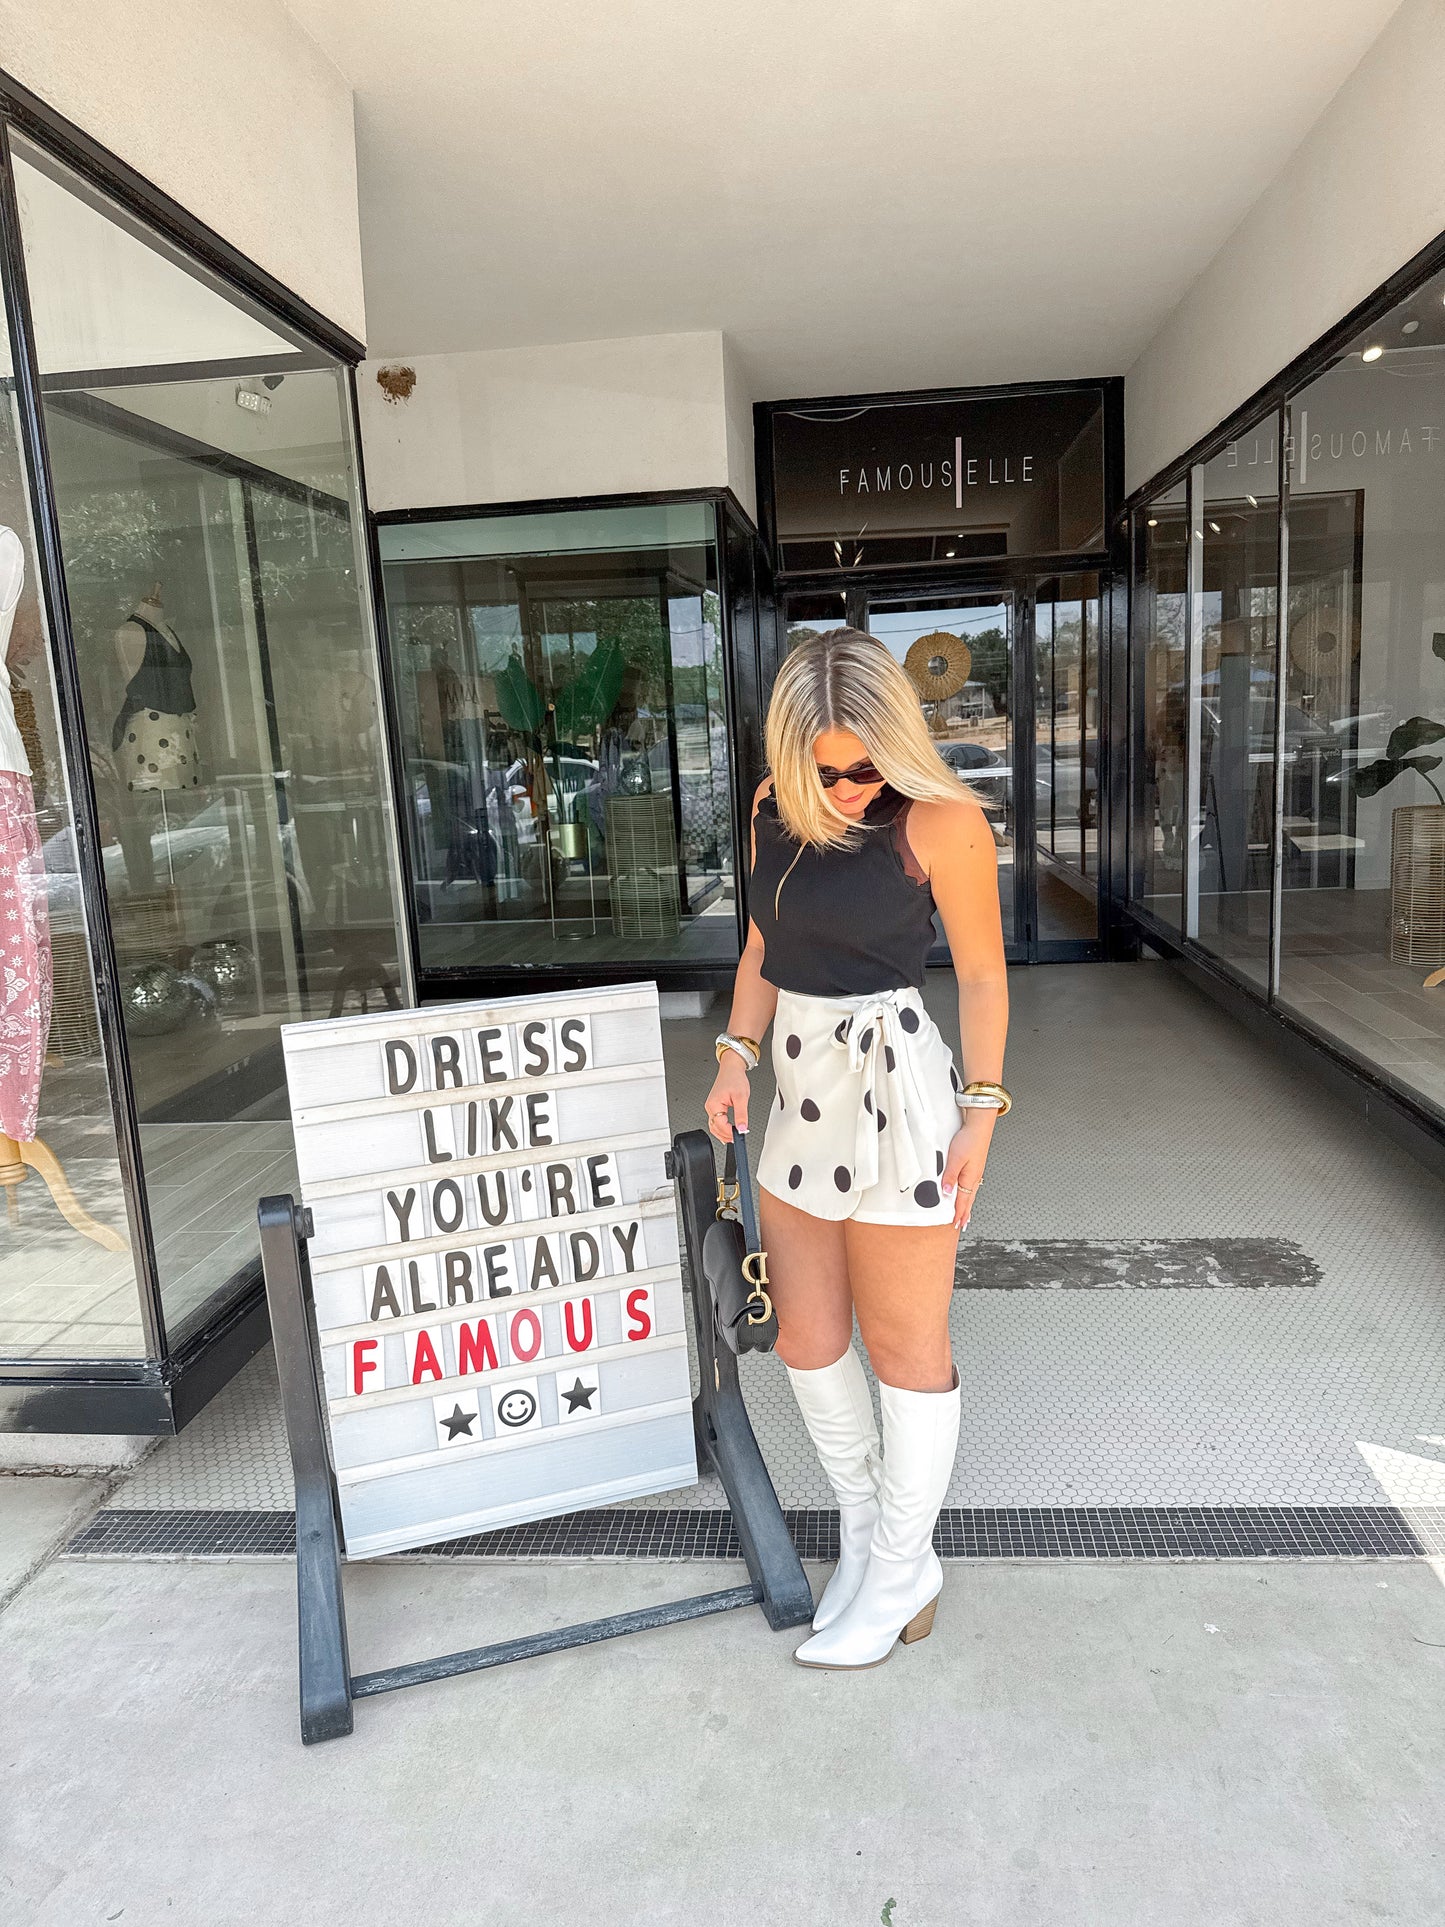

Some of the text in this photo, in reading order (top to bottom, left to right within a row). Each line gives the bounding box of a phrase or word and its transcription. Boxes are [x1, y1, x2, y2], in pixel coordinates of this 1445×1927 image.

[839, 456, 1033, 495] FAMOUS ELLE
[384, 1019, 587, 1095] DRESS
[423, 1092, 553, 1163] LIKE
[386, 1153, 616, 1242] YOU'RE
[370, 1221, 640, 1321] ALREADY
[353, 1288, 651, 1395] FAMOUS
